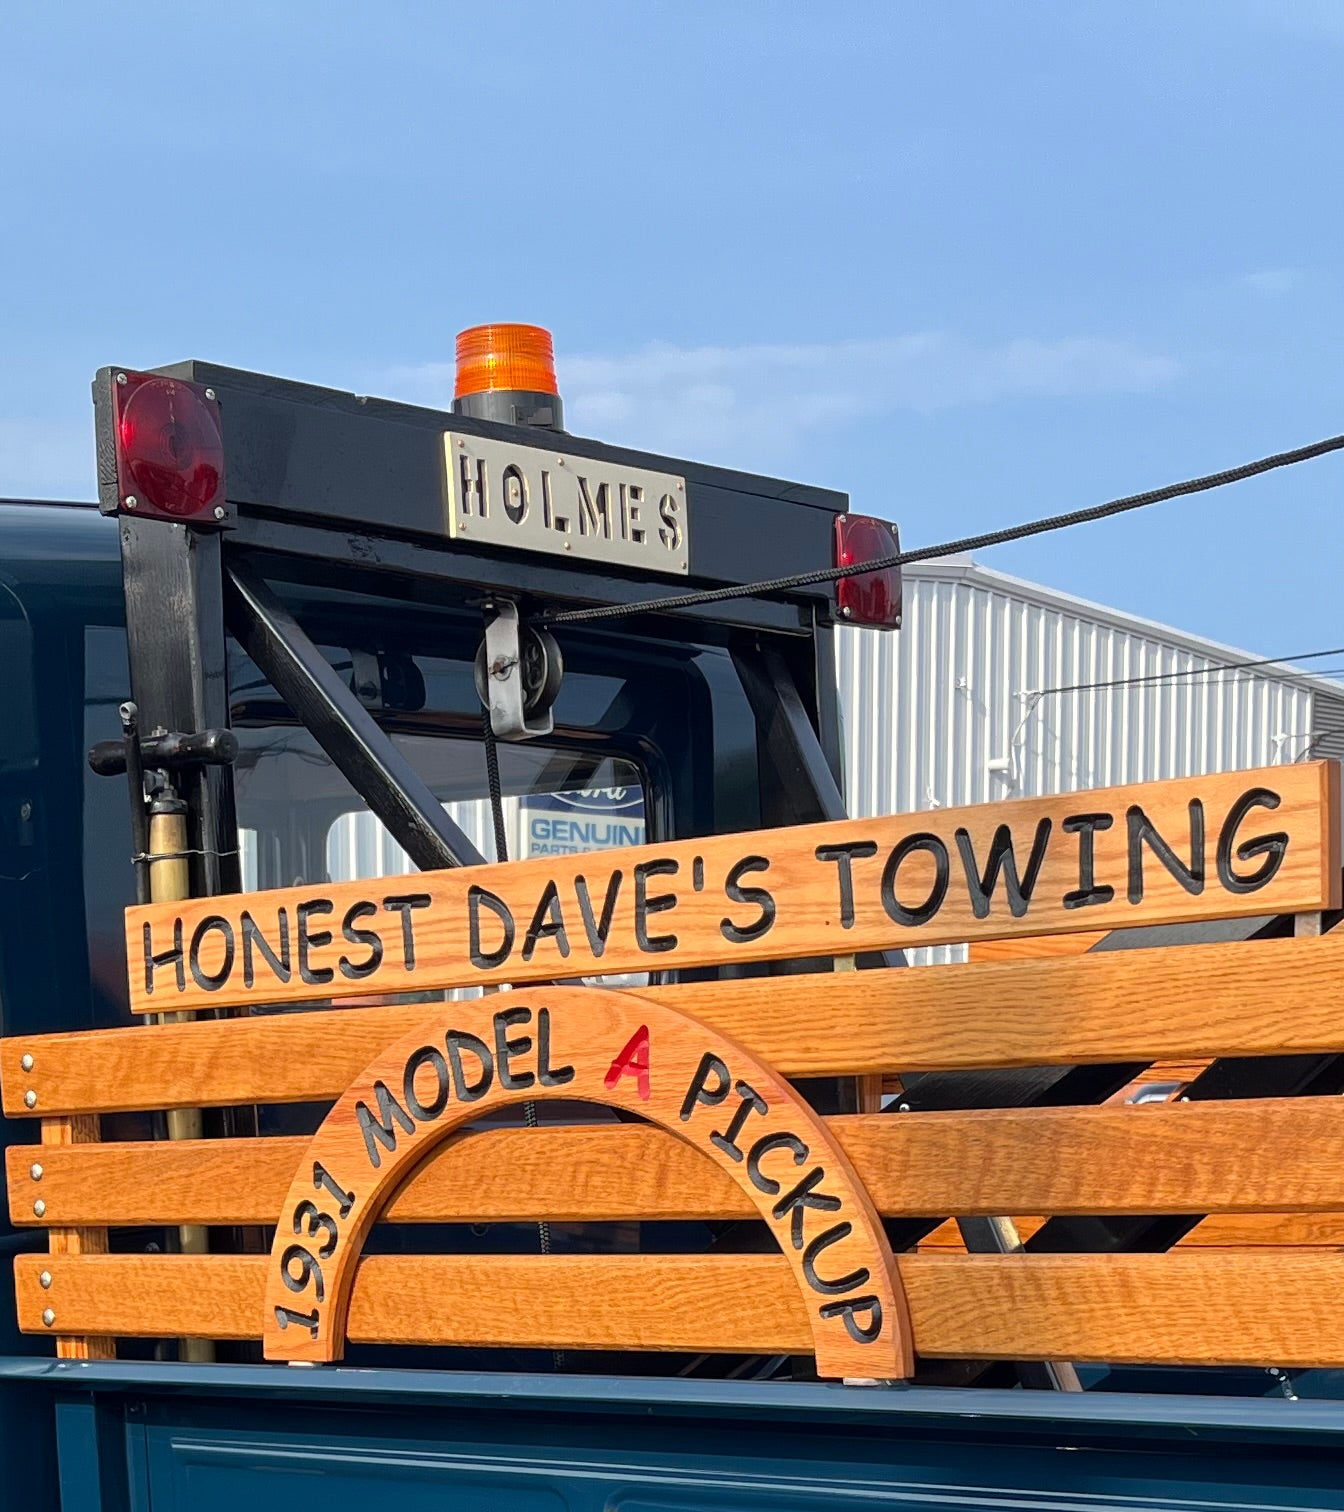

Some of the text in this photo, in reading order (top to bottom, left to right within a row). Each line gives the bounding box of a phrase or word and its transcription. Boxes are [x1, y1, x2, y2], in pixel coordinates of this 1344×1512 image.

[459, 454, 683, 551] HOLMES
[143, 787, 1290, 995] HONEST DAVE'S TOWING
[531, 818, 645, 846] GENUIN
[274, 1006, 883, 1346] 1931 MODEL A PICKUP
